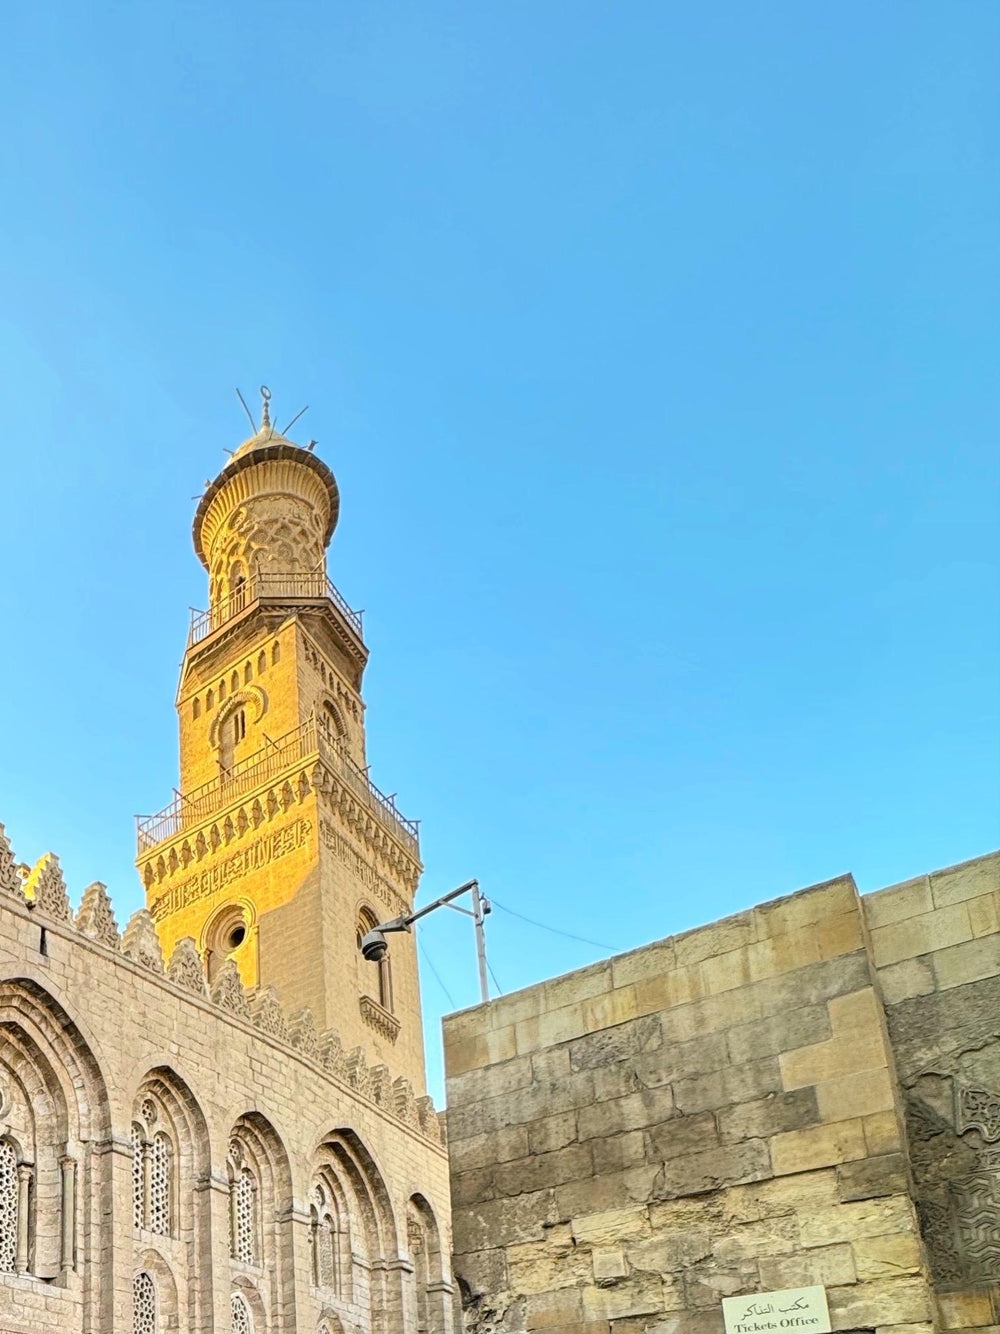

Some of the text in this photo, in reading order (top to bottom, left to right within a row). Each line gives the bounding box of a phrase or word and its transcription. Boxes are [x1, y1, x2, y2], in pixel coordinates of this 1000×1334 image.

[741, 1297, 809, 1321] مكتب التذاكر
[734, 1317, 819, 1333] Tickets Office
